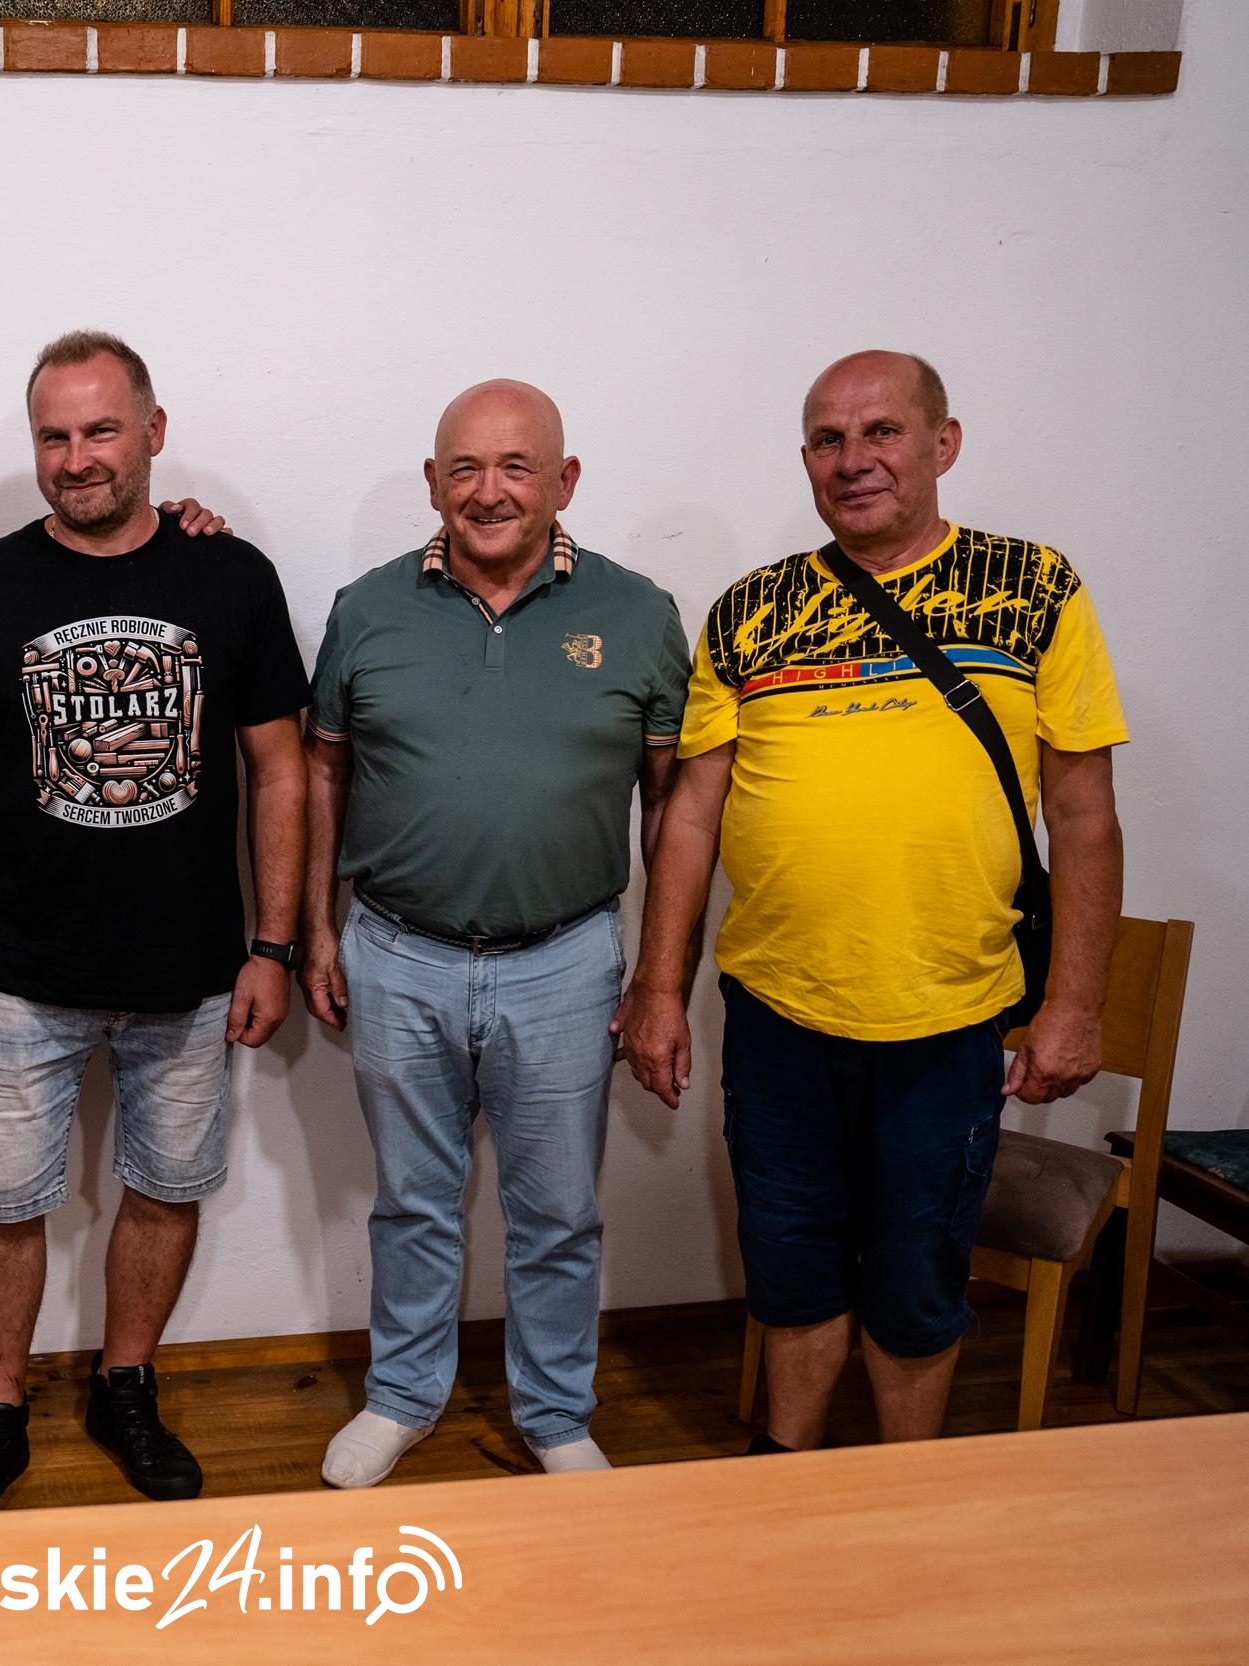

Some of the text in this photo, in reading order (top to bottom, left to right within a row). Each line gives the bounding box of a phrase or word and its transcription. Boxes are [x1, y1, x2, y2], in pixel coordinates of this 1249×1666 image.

[54, 619, 167, 645] RĘCZNIE ROBIONE
[52, 687, 179, 726] STOLARZ
[63, 797, 178, 825] SERCEM TWORZONE
